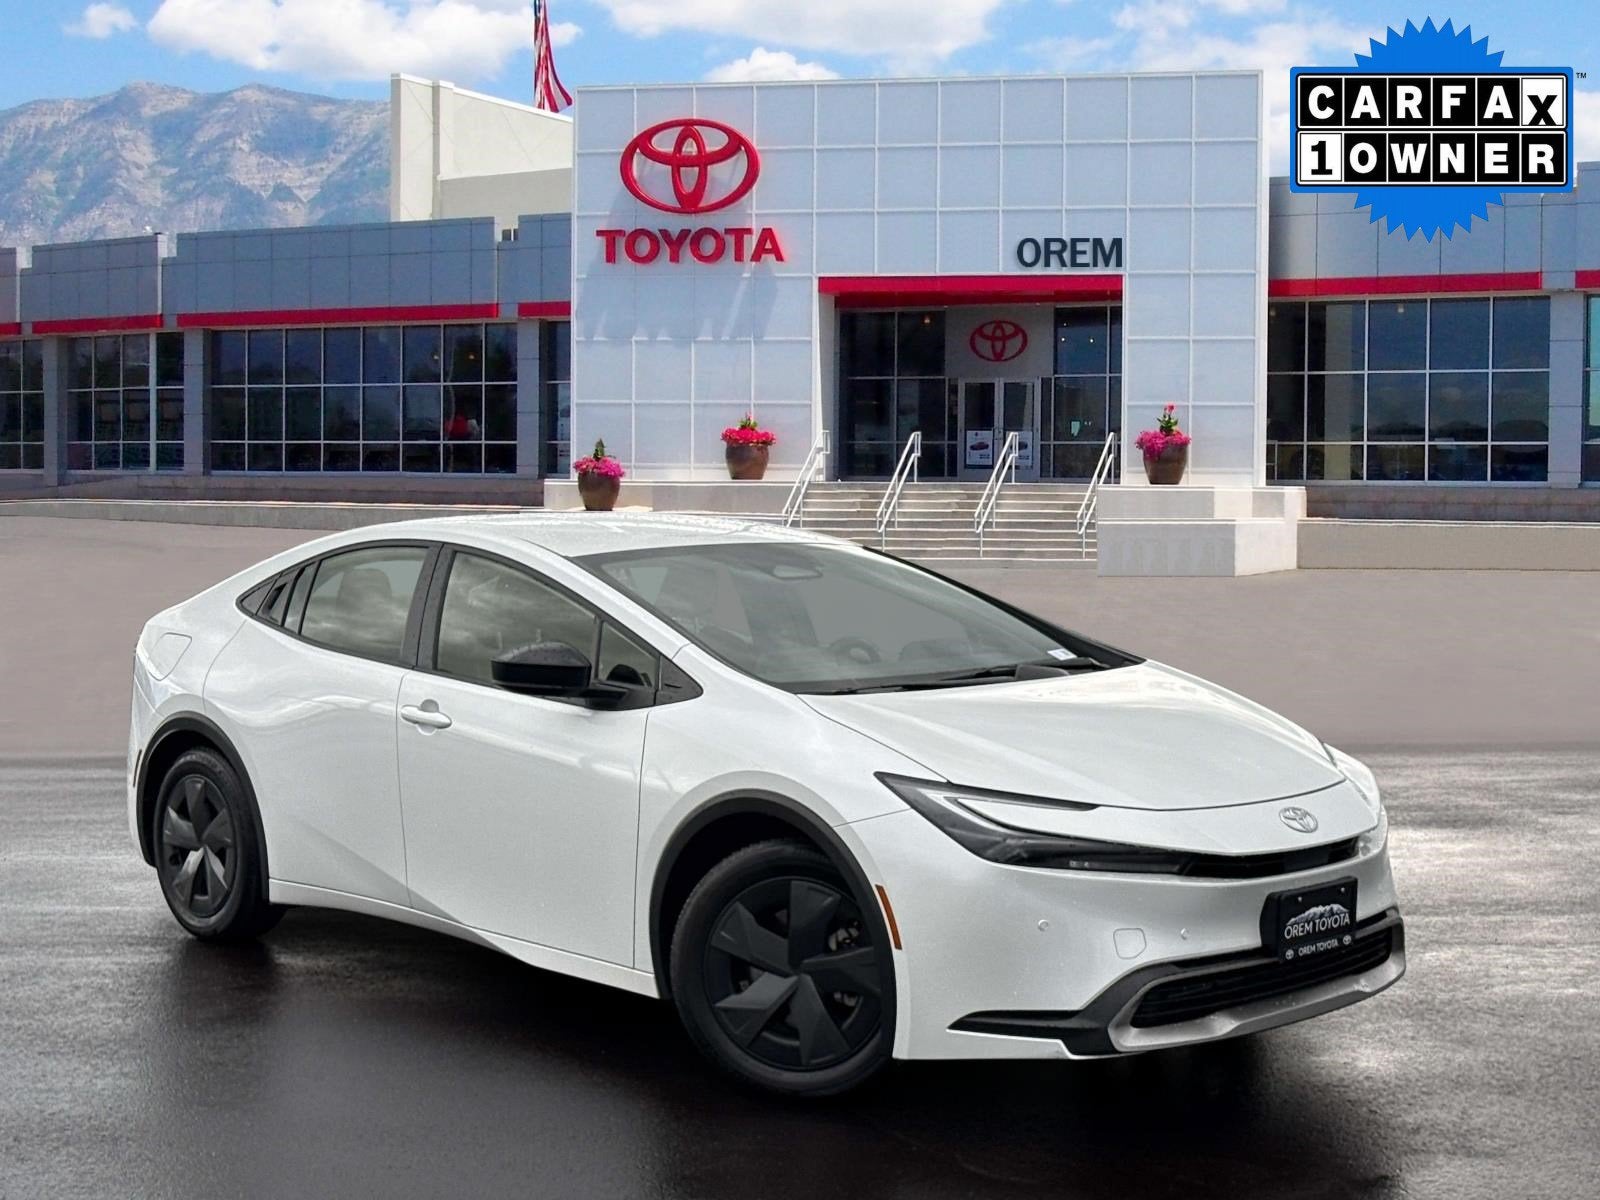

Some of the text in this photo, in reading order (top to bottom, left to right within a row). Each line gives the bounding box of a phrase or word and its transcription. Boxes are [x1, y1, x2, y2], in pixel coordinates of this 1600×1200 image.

[596, 227, 785, 264] TOYOTA
[1017, 237, 1123, 268] OREM
[1284, 912, 1350, 939] OREM TOYOTA
[1298, 939, 1339, 956] OREM TOYOTA
